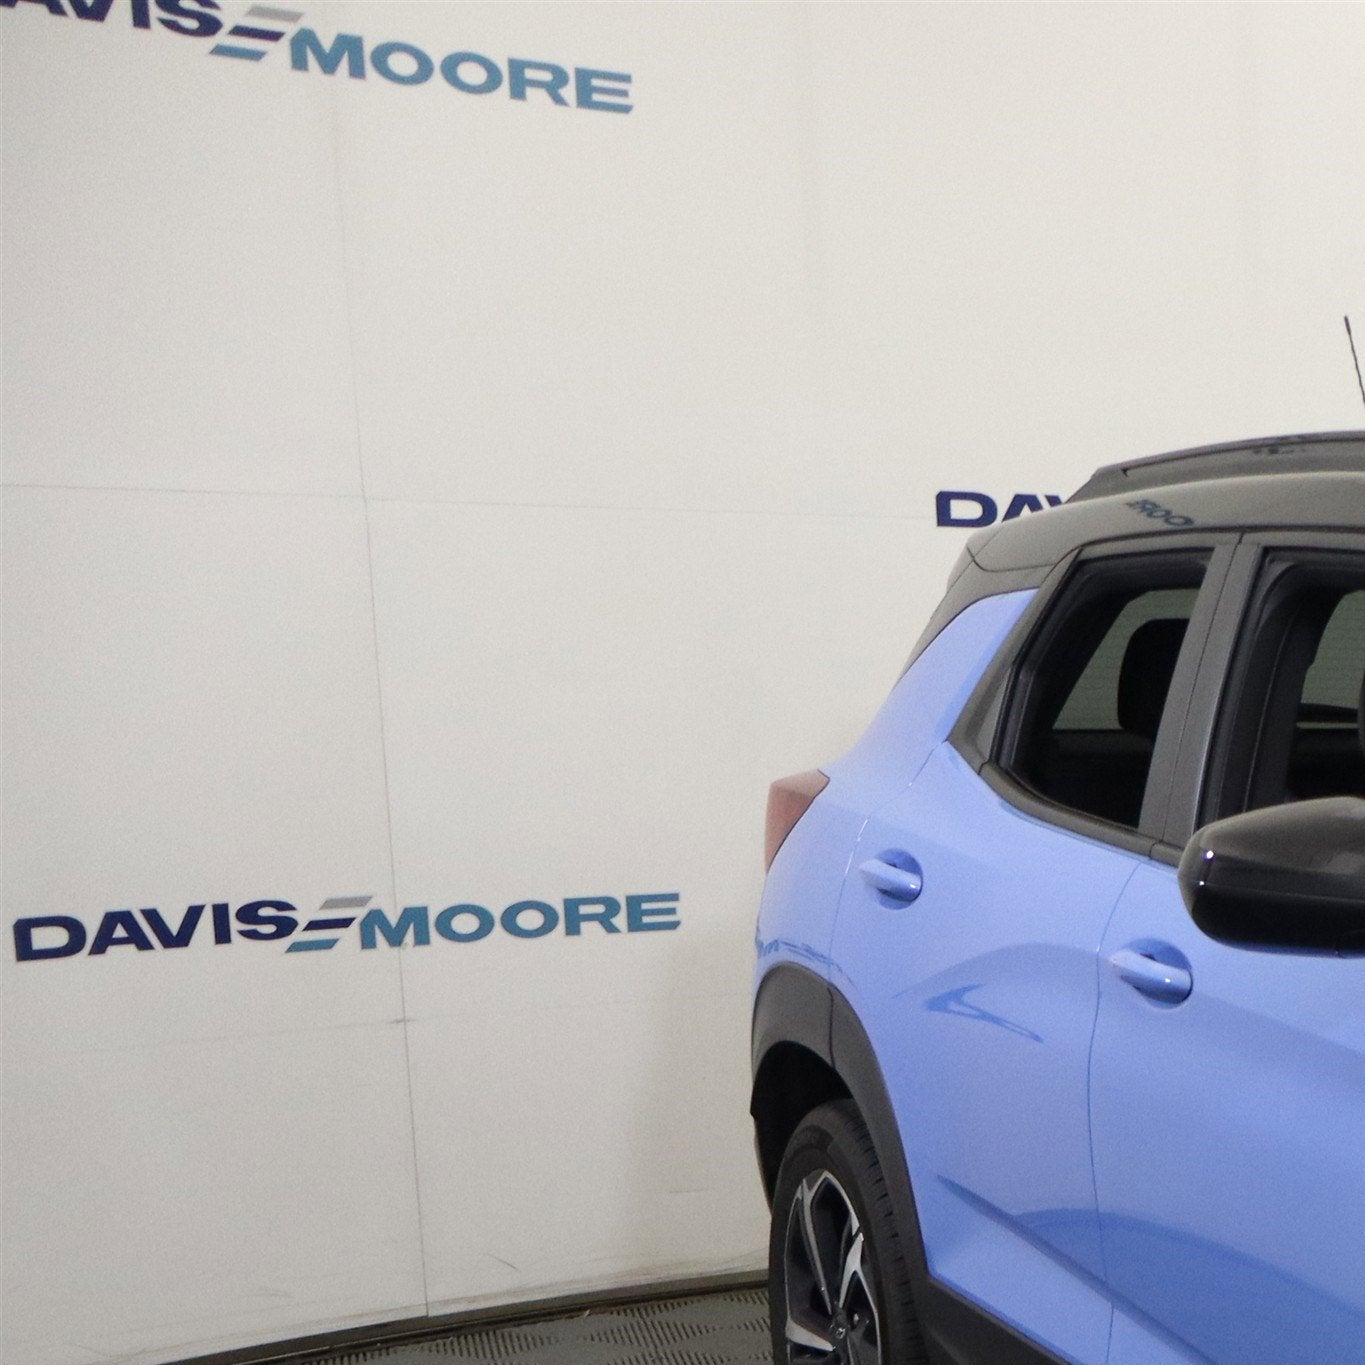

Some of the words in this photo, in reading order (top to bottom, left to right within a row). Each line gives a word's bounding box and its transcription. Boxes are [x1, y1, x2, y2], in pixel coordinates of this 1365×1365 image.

[289, 26, 634, 114] MOORE
[935, 489, 1064, 528] DA
[13, 898, 300, 962] DAVIS
[358, 891, 682, 951] MOORE
